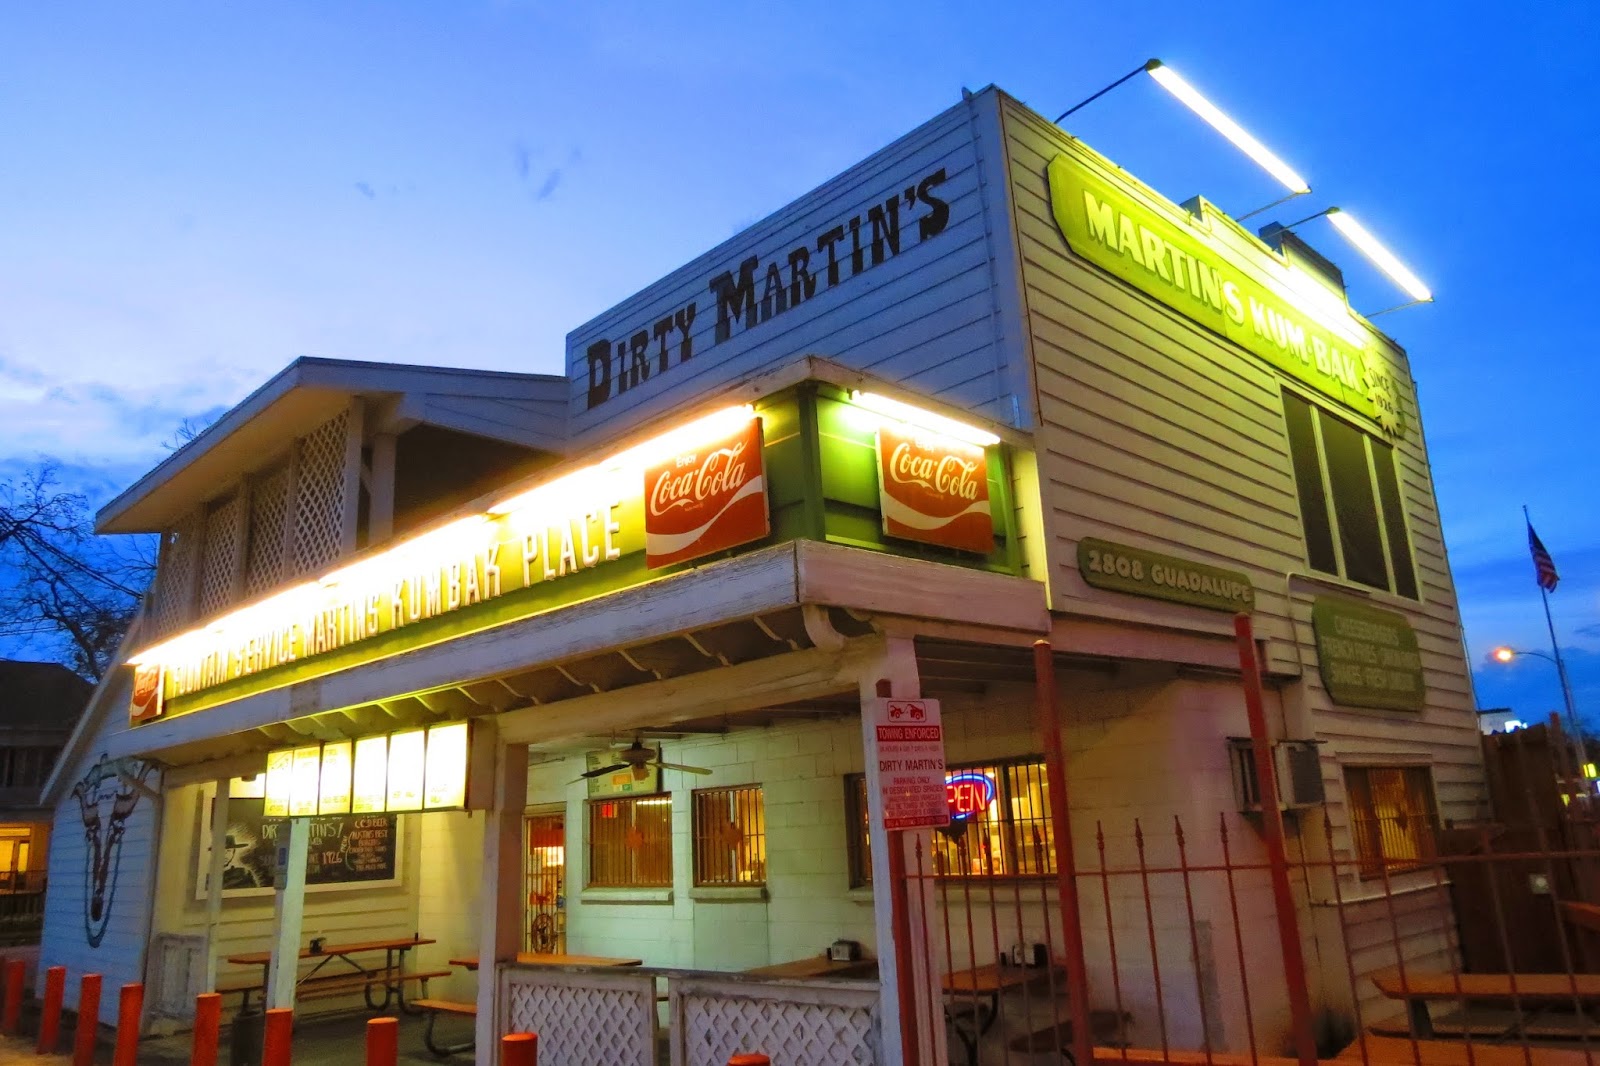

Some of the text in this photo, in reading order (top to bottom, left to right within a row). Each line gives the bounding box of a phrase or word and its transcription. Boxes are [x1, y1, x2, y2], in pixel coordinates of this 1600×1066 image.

[1084, 189, 1245, 327] MARTIN'S
[587, 168, 950, 410] DIRTY MARTIN'S
[650, 440, 748, 517] Coca-Cola
[889, 441, 979, 501] Coca-Cola
[390, 541, 502, 631] KUMBAK
[521, 499, 621, 589] PLACE
[1088, 549, 1251, 605] 2808 GUADALUPE
[878, 727, 939, 740] TOWING ENFORCED
[879, 758, 944, 772] DIRTY MARTIN'S
[893, 776, 931, 785] PARKING ONLY
[946, 783, 986, 813] PEN
[322, 850, 343, 865] 1926
